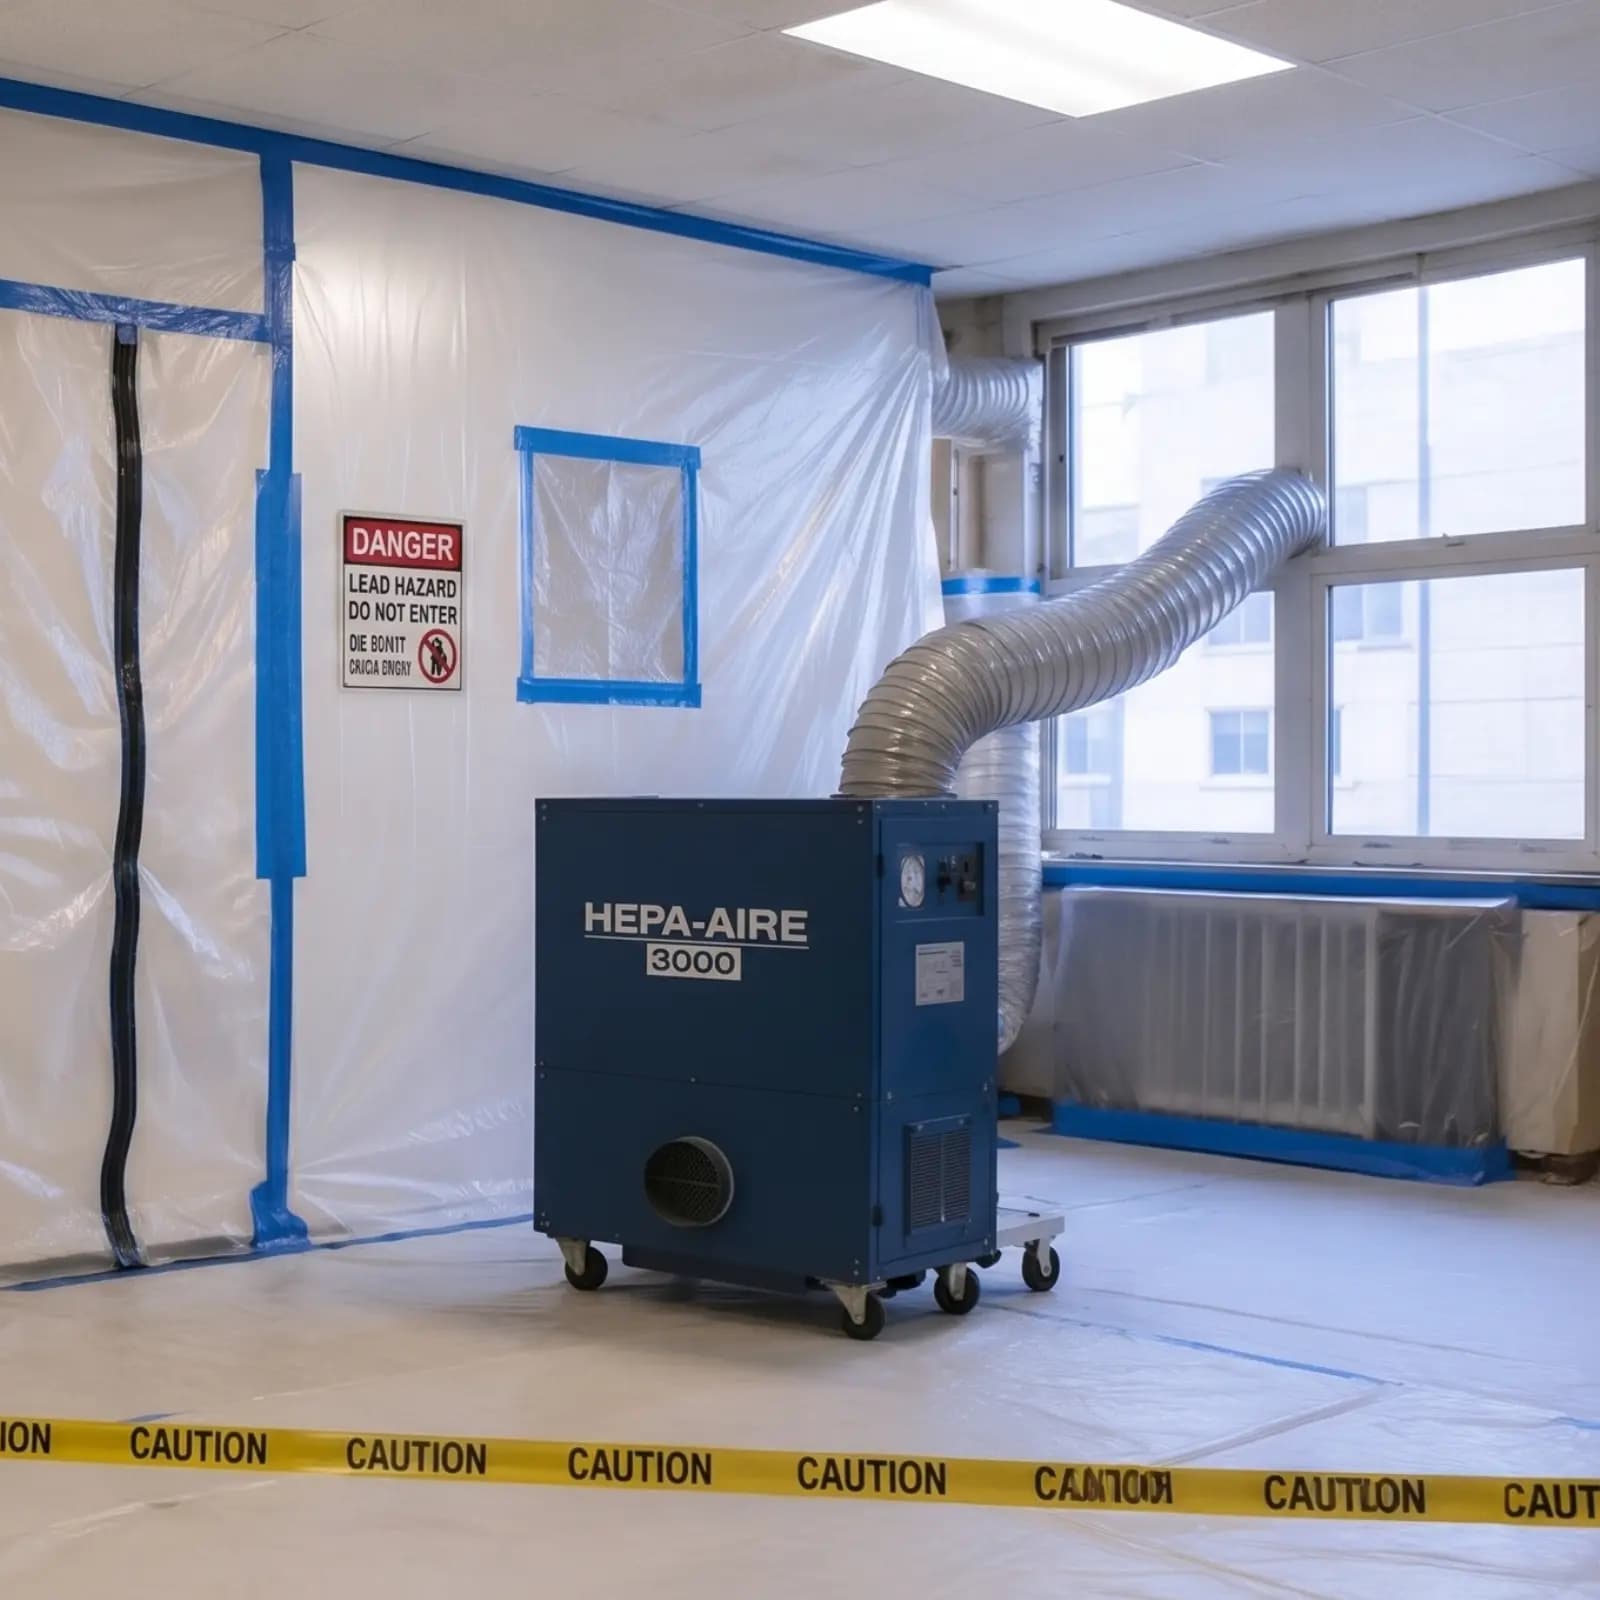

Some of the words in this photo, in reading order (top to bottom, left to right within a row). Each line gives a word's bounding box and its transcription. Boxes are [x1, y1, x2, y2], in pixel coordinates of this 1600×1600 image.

[352, 528, 454, 561] DANGER
[349, 573, 390, 595] LEAD
[395, 576, 457, 598] HAZARD
[349, 601, 370, 621] DO
[375, 602, 406, 622] NOT
[410, 604, 457, 625] ENTER
[584, 902, 809, 943] HEPA-AIRE
[651, 948, 736, 976] 3000
[130, 1427, 267, 1464] CAUTION
[347, 1438, 487, 1475] CAUTION
[568, 1448, 712, 1485] CAUTION
[798, 1457, 946, 1495] CAUTION
